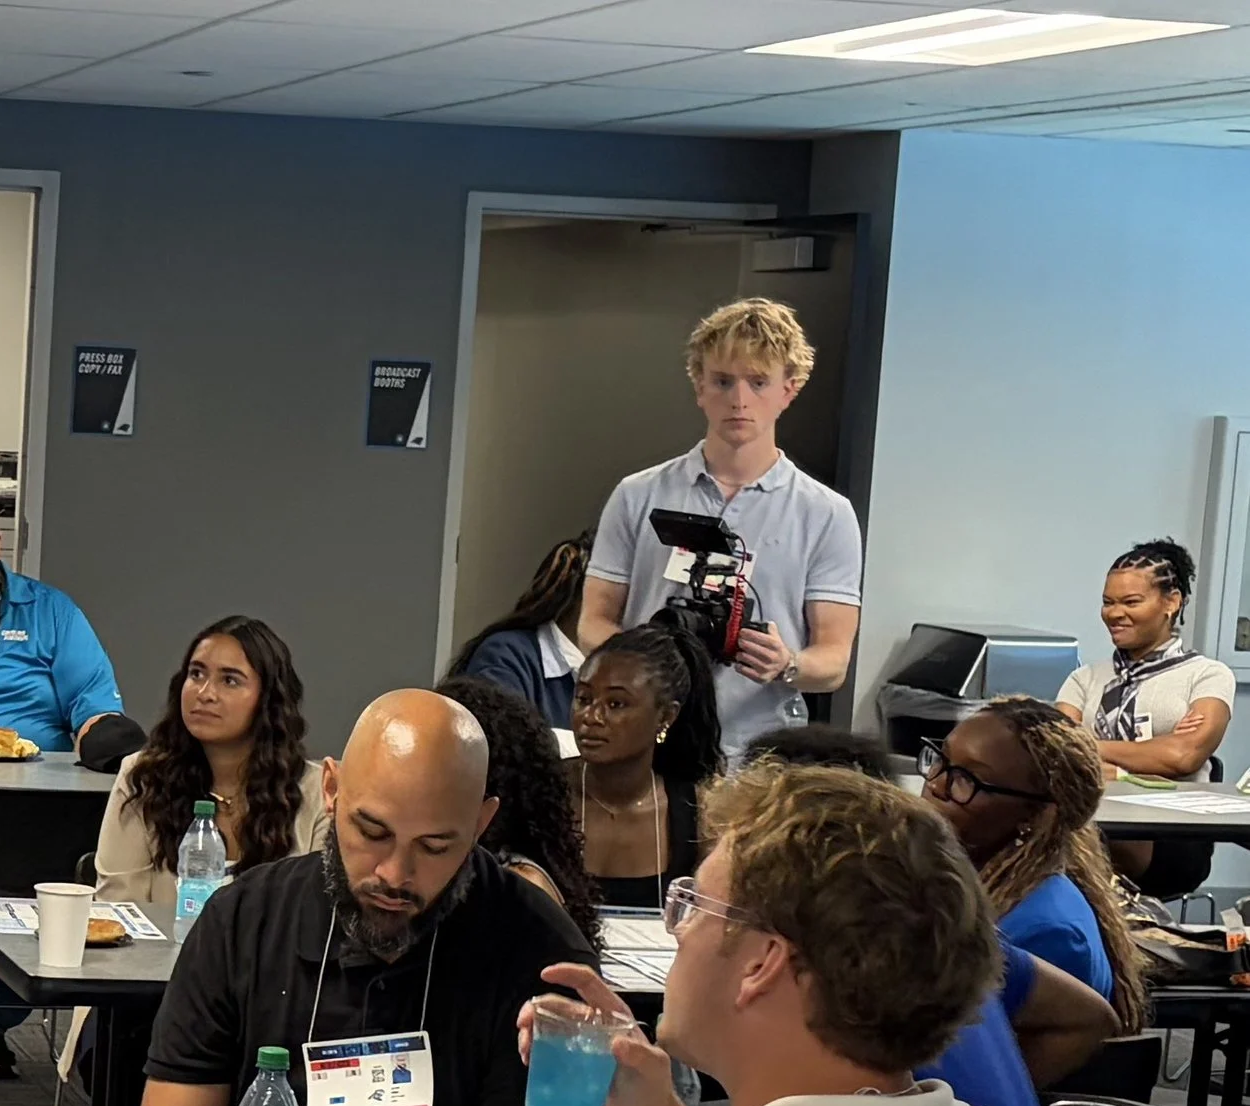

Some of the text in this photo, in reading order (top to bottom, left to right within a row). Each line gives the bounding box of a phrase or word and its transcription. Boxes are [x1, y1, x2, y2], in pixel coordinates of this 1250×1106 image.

[78, 352, 125, 364] PRESS BOX
[374, 366, 422, 378] BROADCAST
[373, 377, 407, 389] BOOTHS
